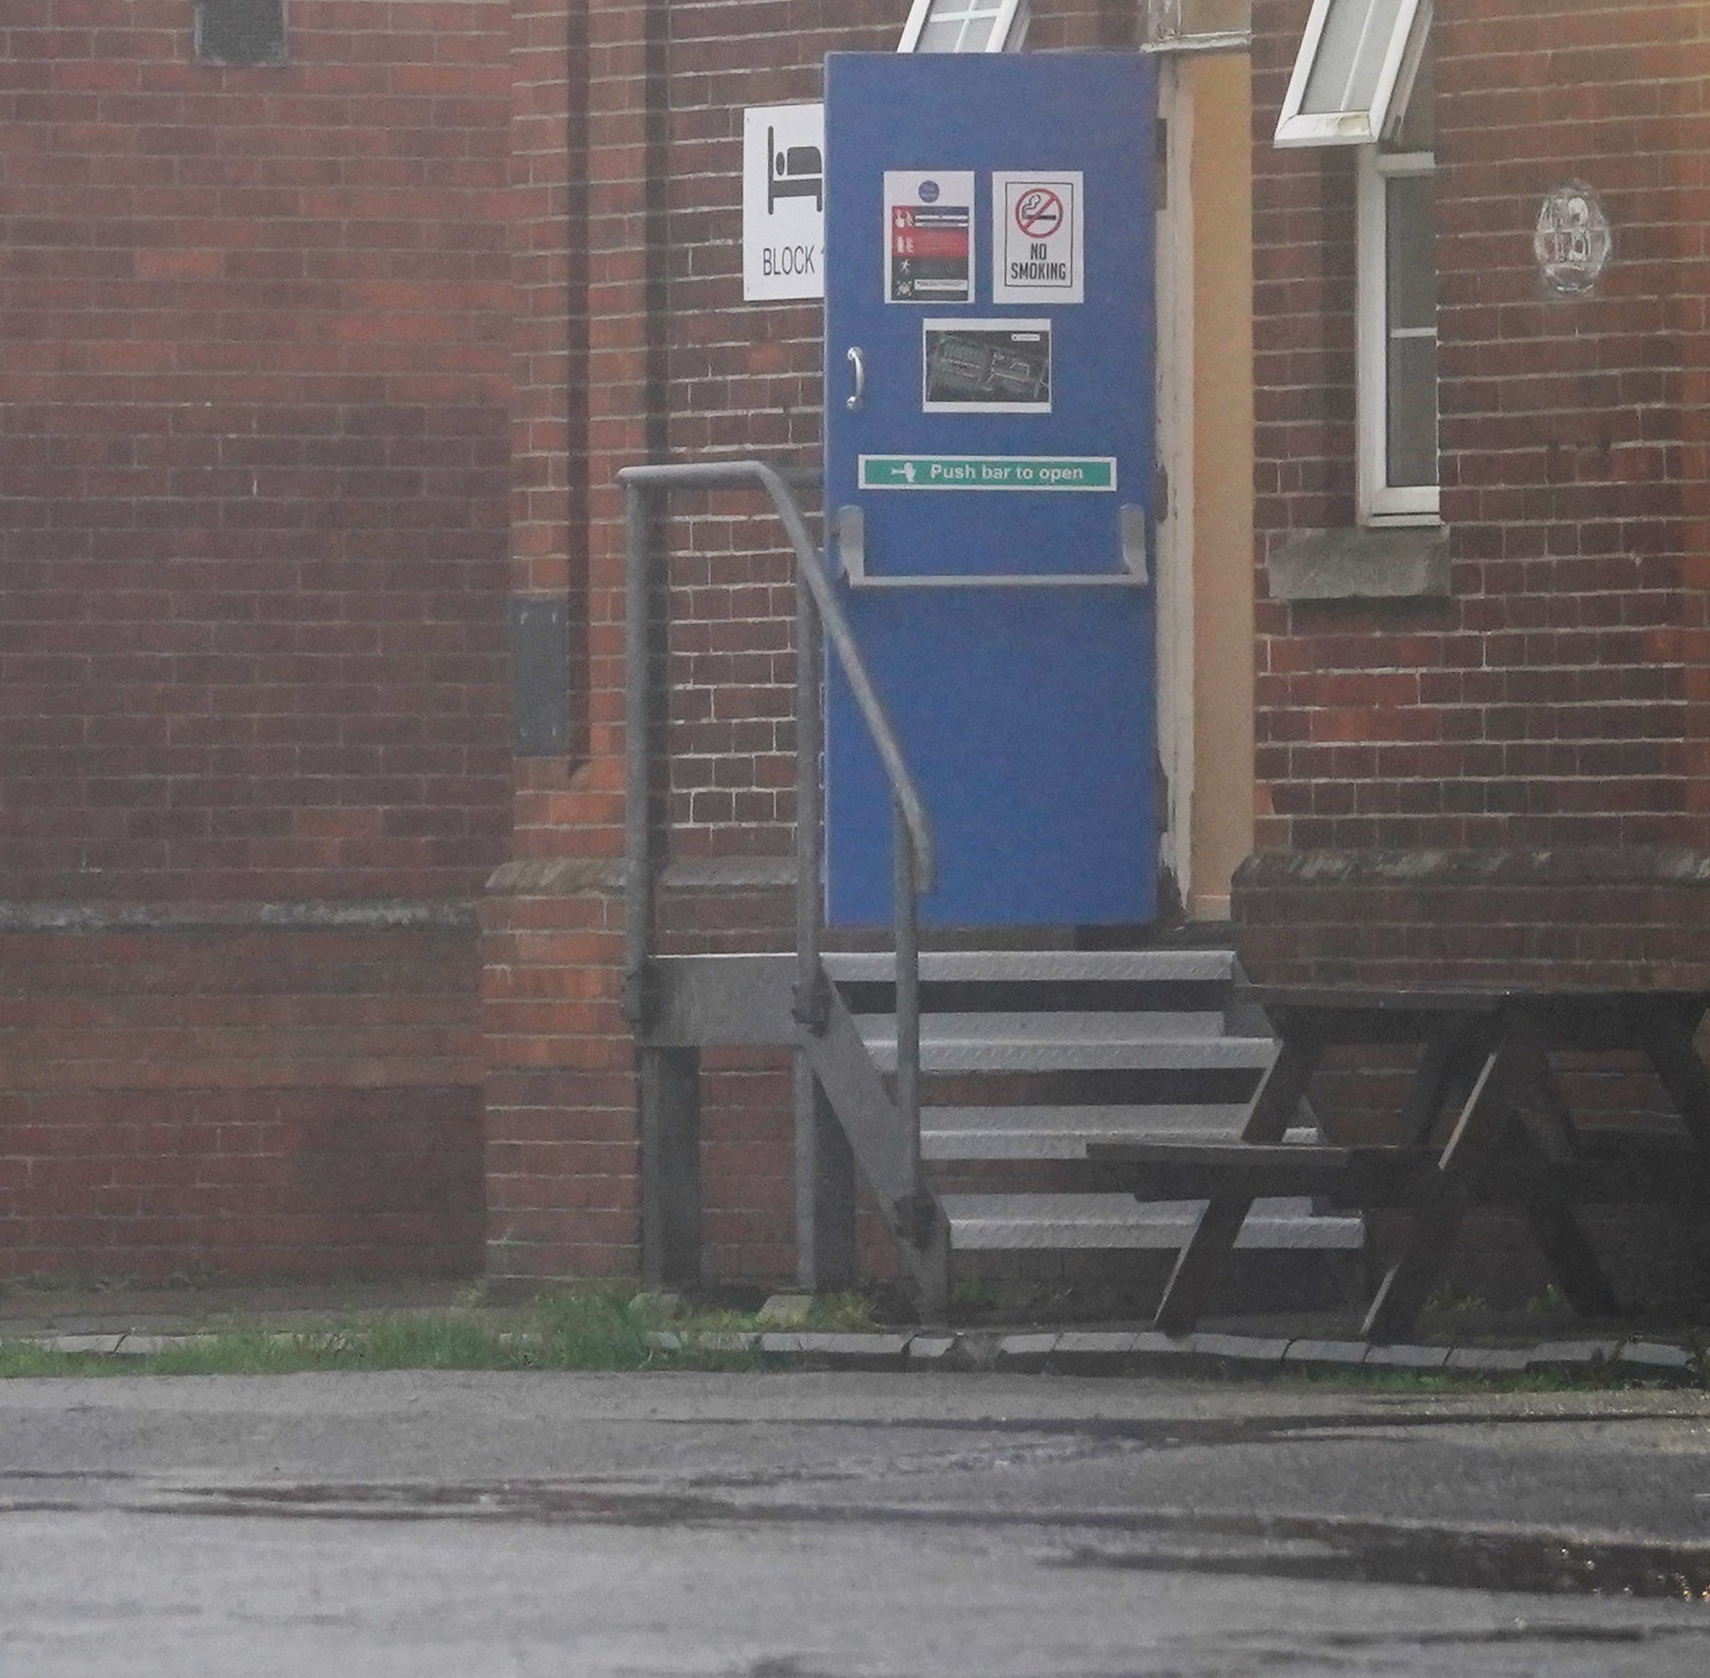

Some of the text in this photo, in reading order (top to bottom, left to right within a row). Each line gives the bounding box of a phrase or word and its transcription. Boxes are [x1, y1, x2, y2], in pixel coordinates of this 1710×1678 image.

[762, 244, 816, 276] BLOCK
[1030, 243, 1047, 260] NO
[1011, 262, 1067, 280] SMOKING
[930, 464, 1084, 483] Push bar to open
